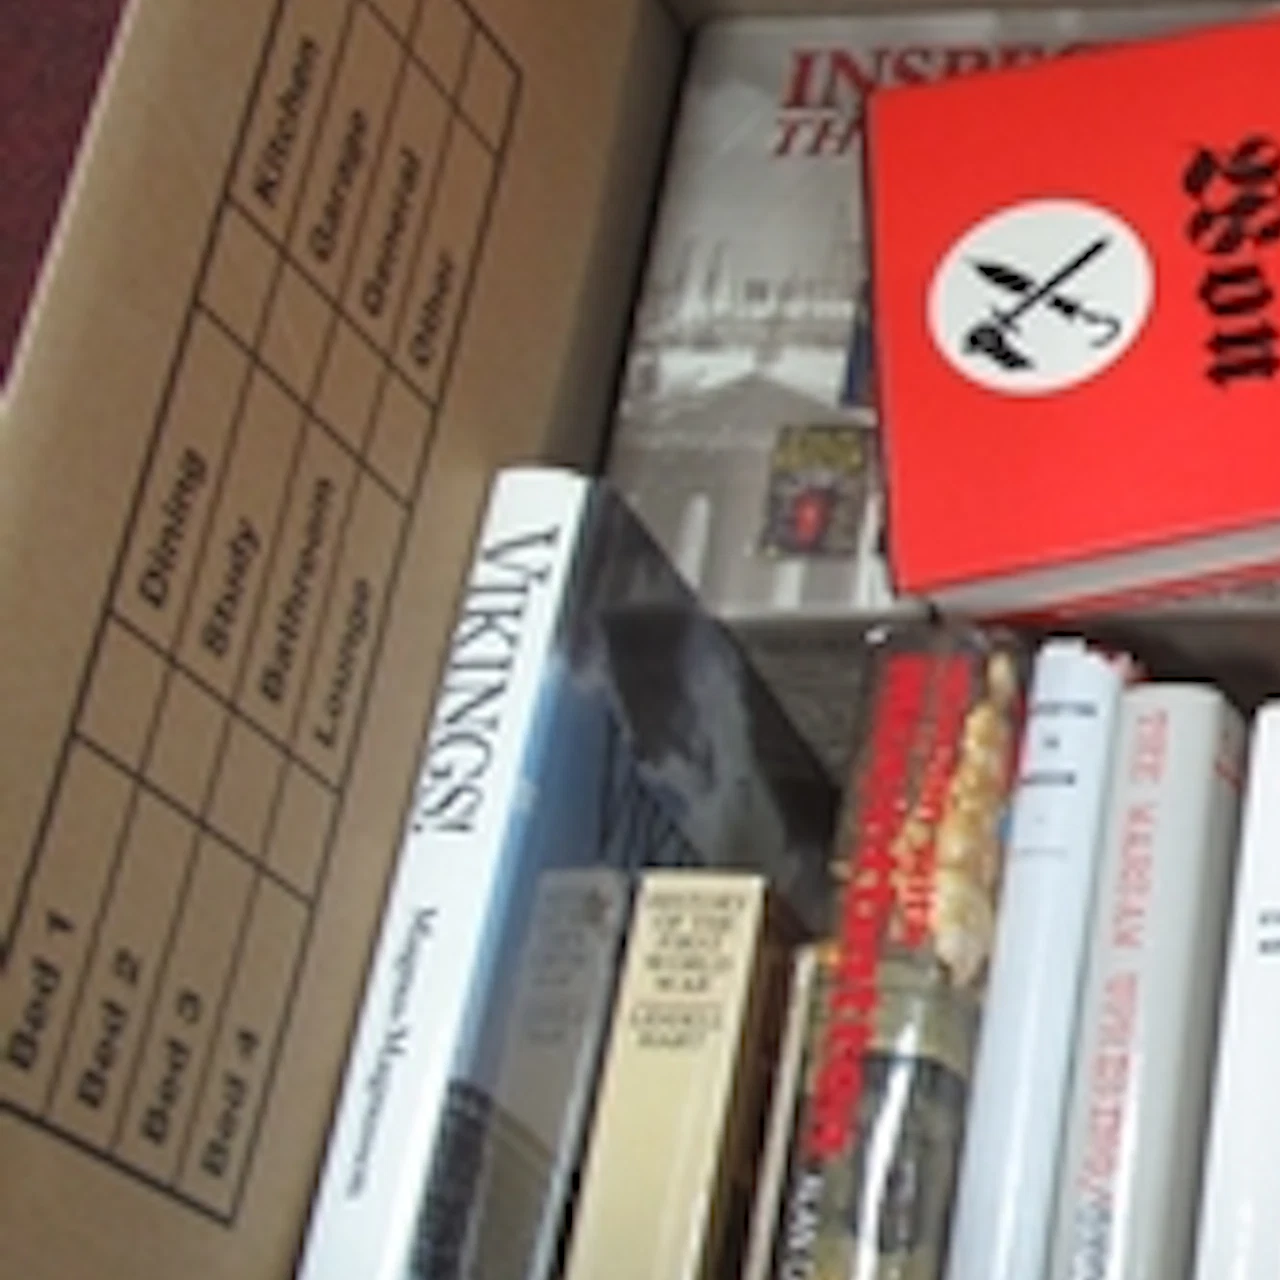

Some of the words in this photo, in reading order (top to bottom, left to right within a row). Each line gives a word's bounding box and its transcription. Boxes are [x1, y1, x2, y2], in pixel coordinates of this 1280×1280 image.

[252, 36, 319, 209] Kitchen
[311, 109, 369, 263] Garage
[771, 113, 861, 158] TH
[360, 147, 422, 317] General
[411, 250, 456, 367] Other
[137, 448, 208, 610] Dining
[202, 520, 262, 661] Study
[258, 477, 333, 705] Bathroom
[314, 578, 373, 750] Lounge
[411, 524, 560, 837] VIKINGS!
[7, 960, 62, 1073] Bed
[76, 1001, 120, 1112] Bed
[110, 949, 140, 985] 2
[139, 1043, 185, 1148] Bed
[176, 993, 203, 1022] 3
[202, 1077, 245, 1182] Bed
[231, 1030, 261, 1057] 4
